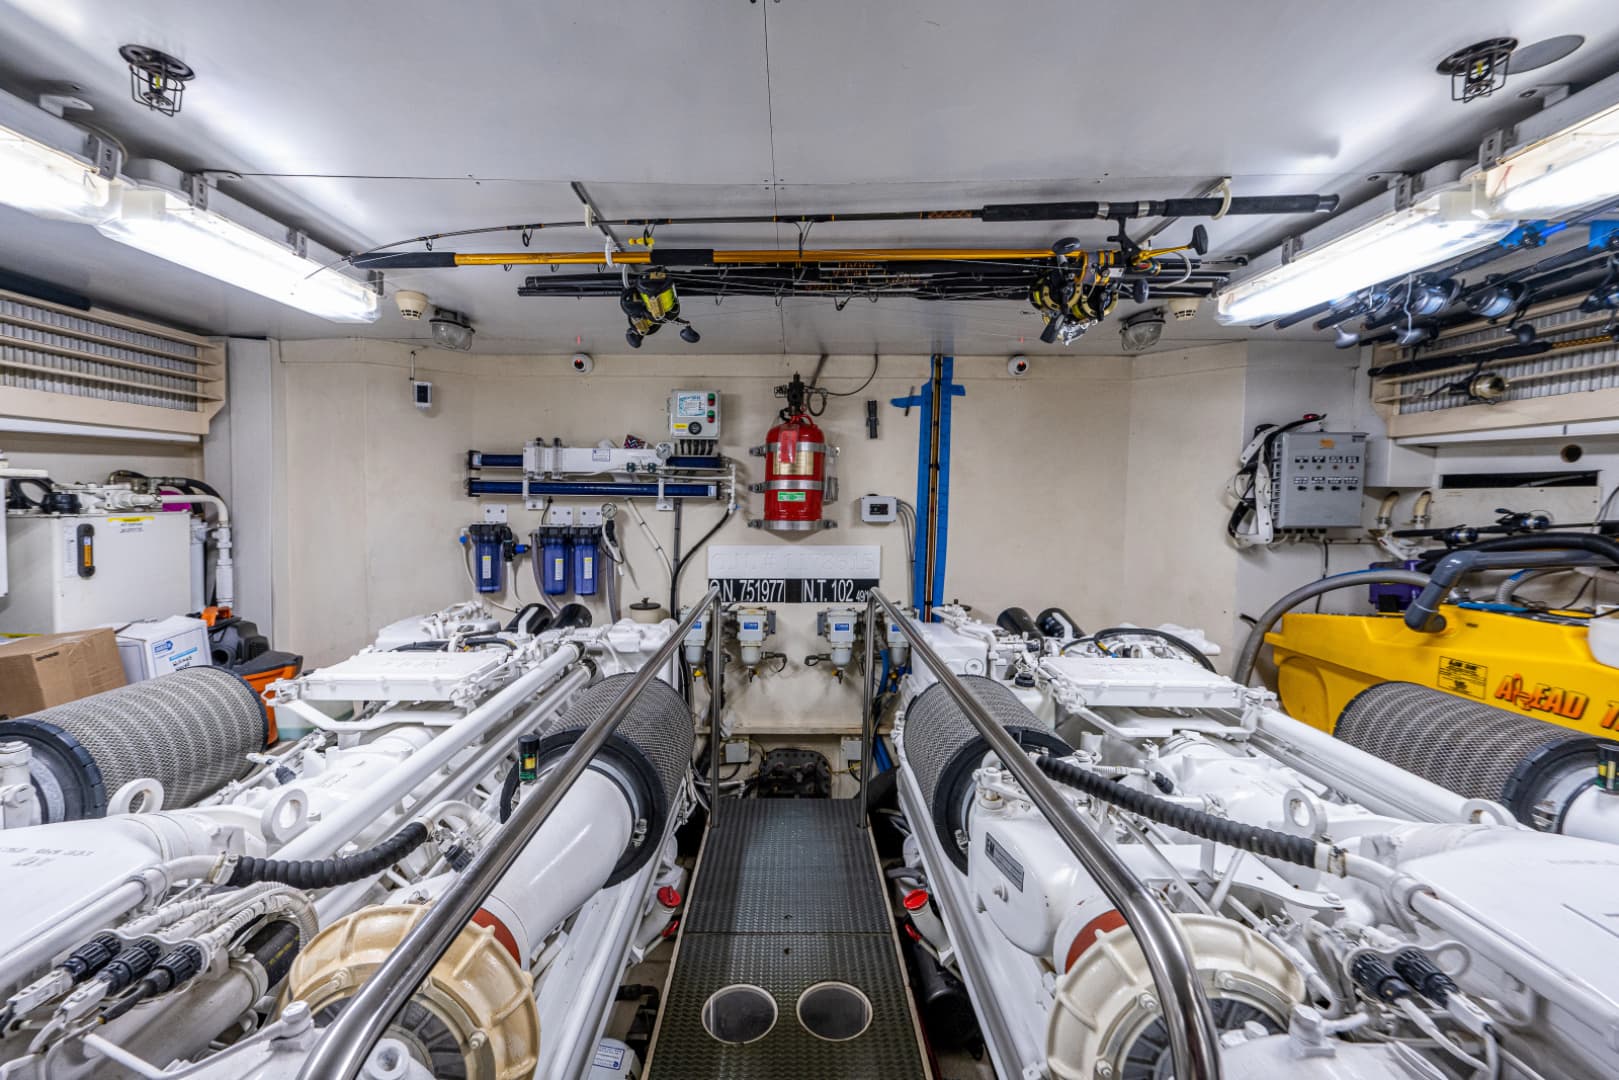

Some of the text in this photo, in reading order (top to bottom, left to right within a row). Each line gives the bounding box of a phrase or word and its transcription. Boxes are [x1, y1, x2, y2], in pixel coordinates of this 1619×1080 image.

[739, 579, 785, 602] 751977
[804, 579, 828, 602] N.T.
[831, 579, 854, 602] 102
